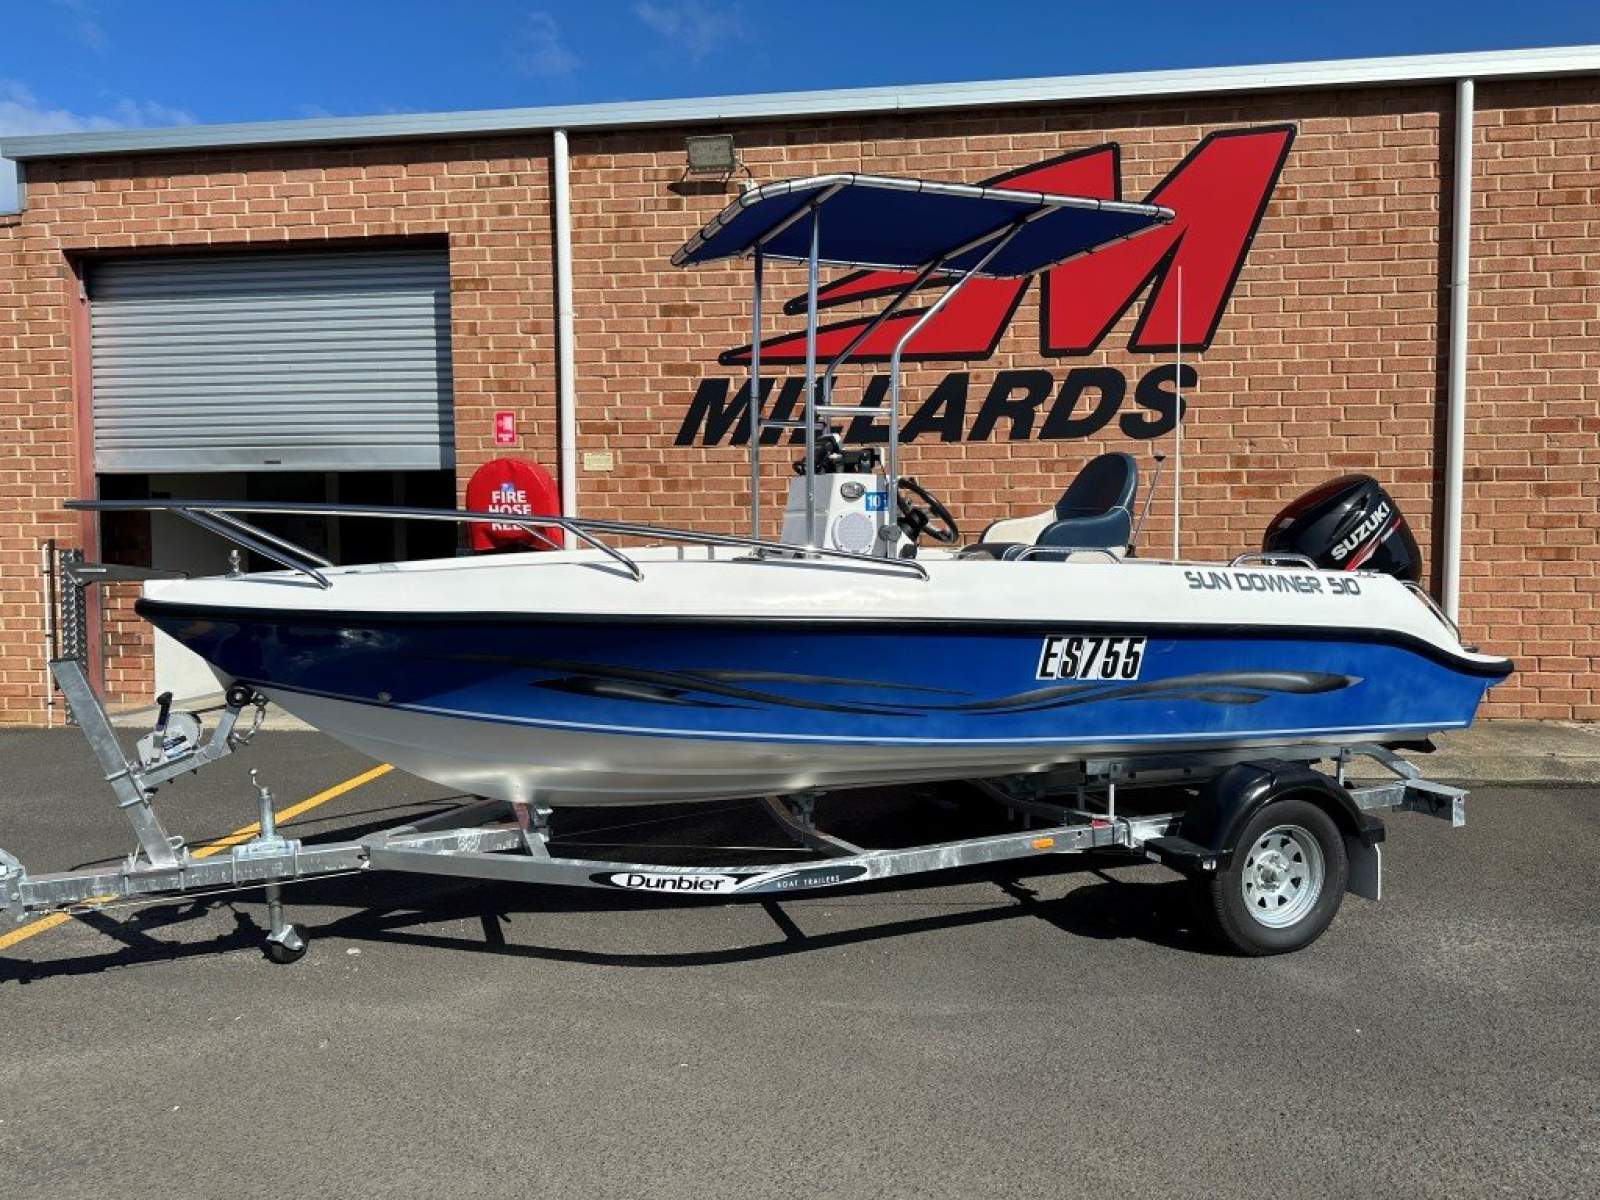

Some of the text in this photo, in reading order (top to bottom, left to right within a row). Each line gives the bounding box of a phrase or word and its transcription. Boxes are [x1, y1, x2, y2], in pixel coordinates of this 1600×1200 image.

[674, 364, 1197, 446] MILLARDS
[491, 490, 528, 503] FIRE
[488, 504, 532, 514] HOSE
[1331, 501, 1390, 560] SUZUKI
[1184, 571, 1361, 595] SUN DOWNER 510
[1039, 636, 1143, 679] ES755
[626, 873, 726, 891] Dunbier
[804, 874, 841, 887] TRAILERS
